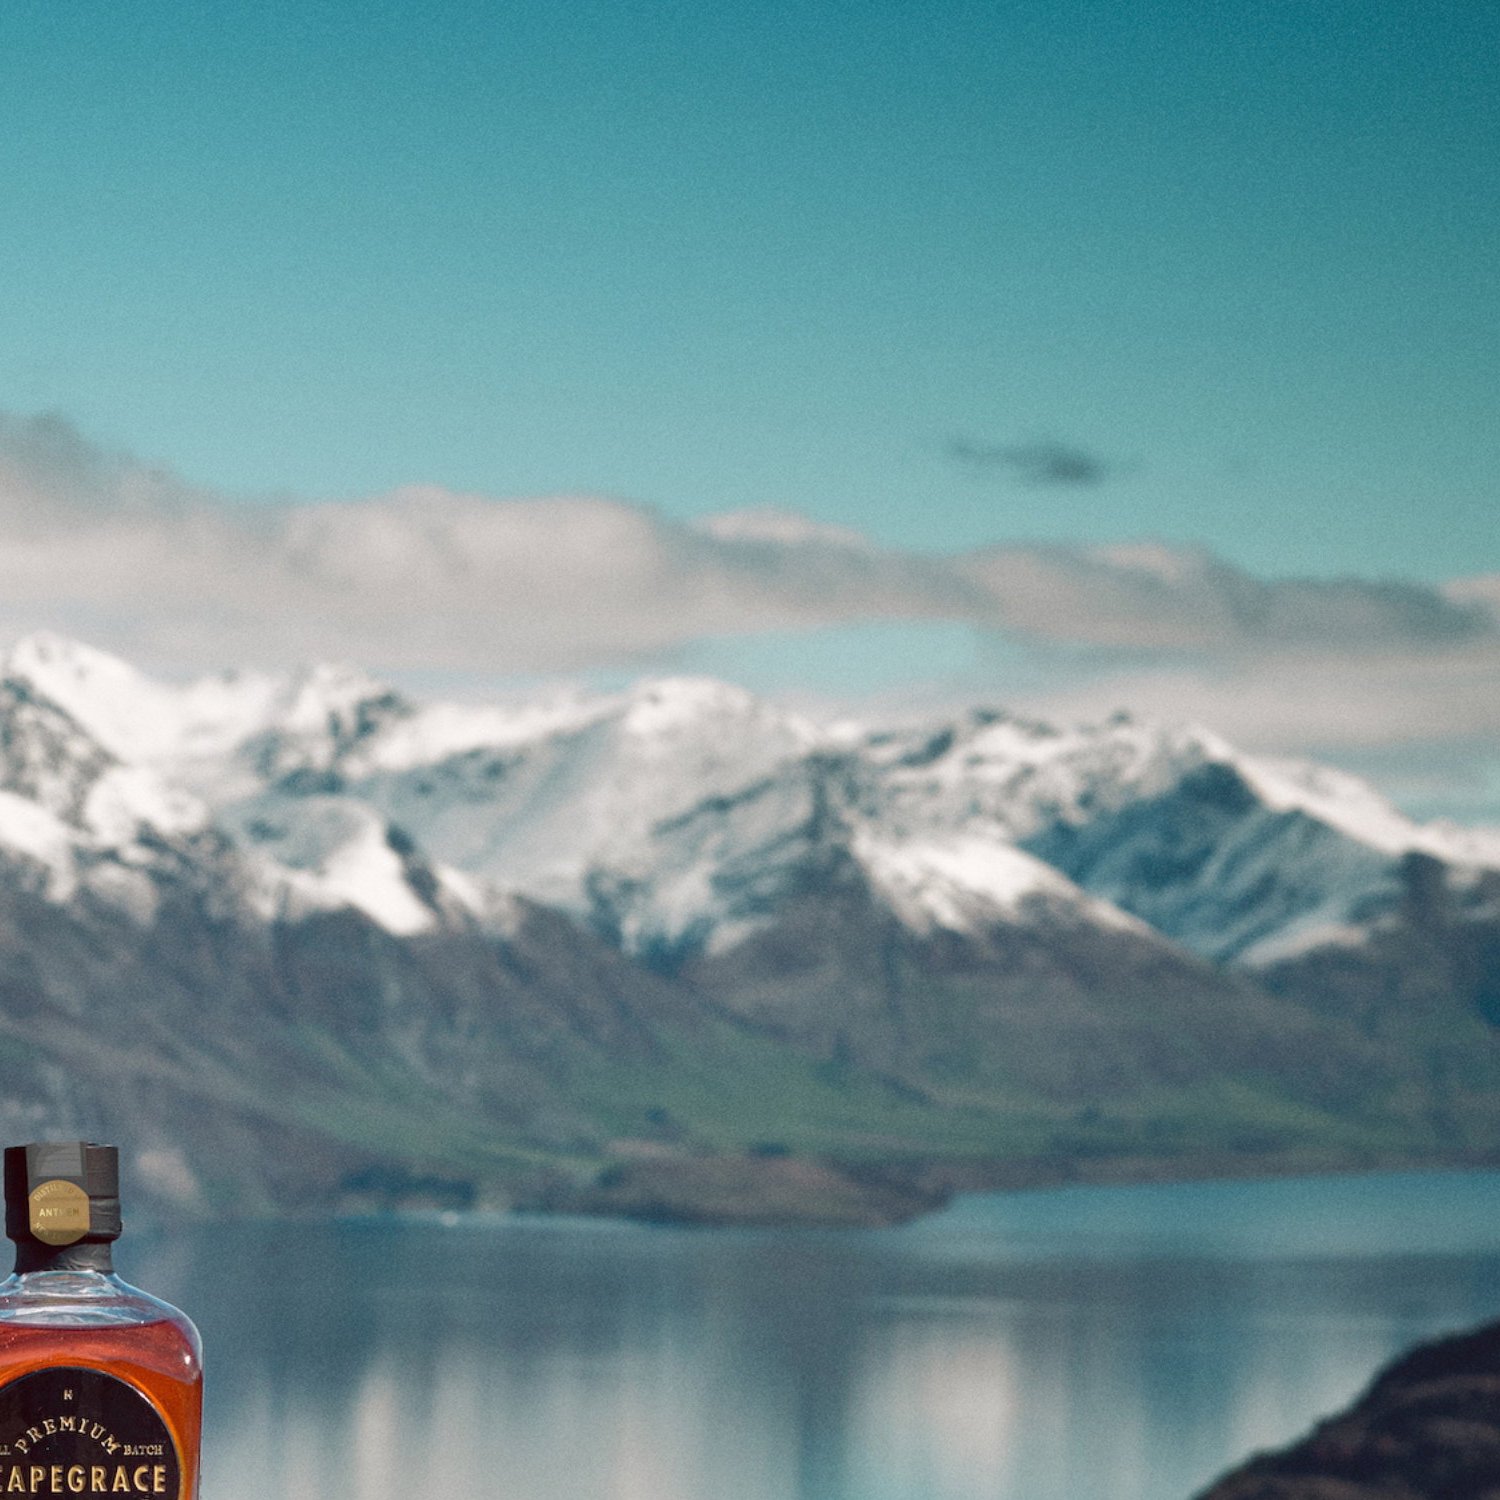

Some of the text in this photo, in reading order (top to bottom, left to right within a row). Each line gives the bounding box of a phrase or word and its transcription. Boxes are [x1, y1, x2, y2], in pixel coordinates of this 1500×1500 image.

[63, 1389, 73, 1400] N
[14, 1416, 121, 1454] PREMIUM
[124, 1444, 163, 1455] BATCH
